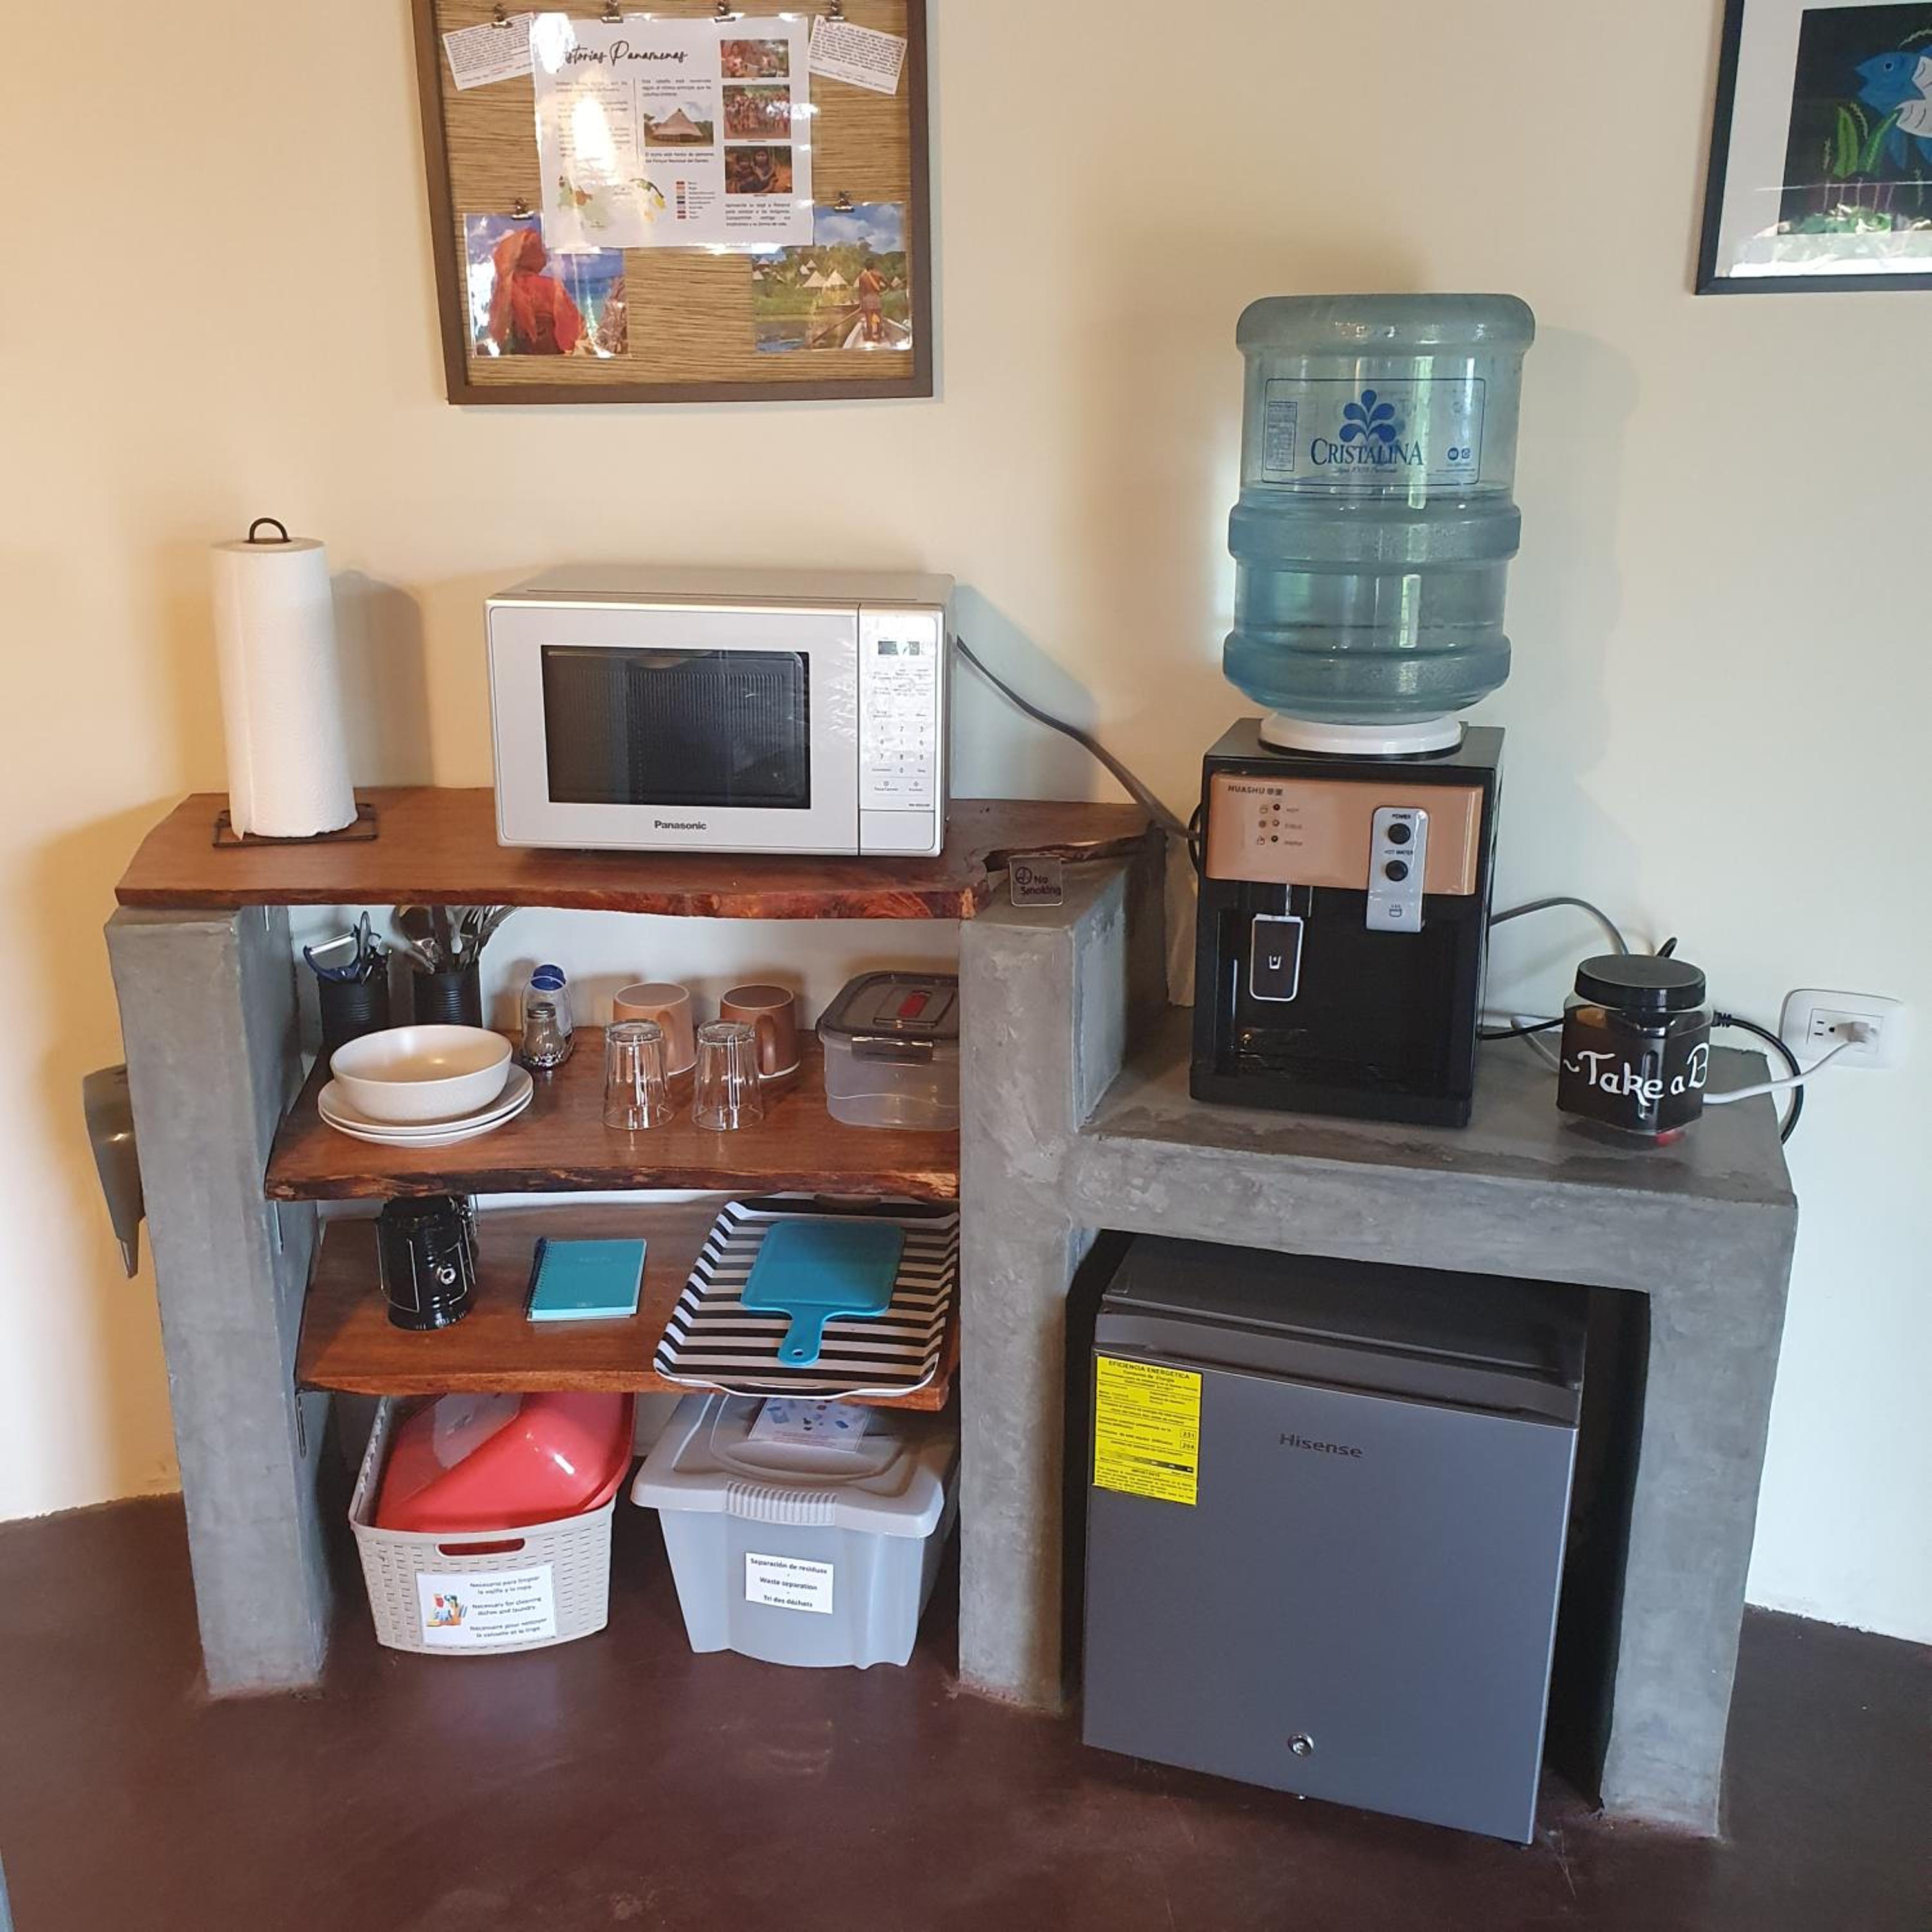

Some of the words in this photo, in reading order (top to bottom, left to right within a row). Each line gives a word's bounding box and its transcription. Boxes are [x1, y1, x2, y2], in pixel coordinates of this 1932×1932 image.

[1311, 437, 1424, 466] CRISTALINA
[1227, 785, 1265, 794] HUASHU
[654, 819, 707, 830] Panasonic
[1034, 875, 1049, 884] No
[1019, 886, 1062, 896] Smoking
[1577, 1050, 1665, 1107] Take
[1670, 1075, 1686, 1095] a
[1108, 1360, 1146, 1372] EFICIENCIA
[1280, 1432, 1363, 1458] Hisense
[750, 1557, 788, 1569] Separación
[799, 1566, 828, 1575] residuos
[759, 1576, 781, 1586] Waste
[782, 1580, 818, 1591] separation
